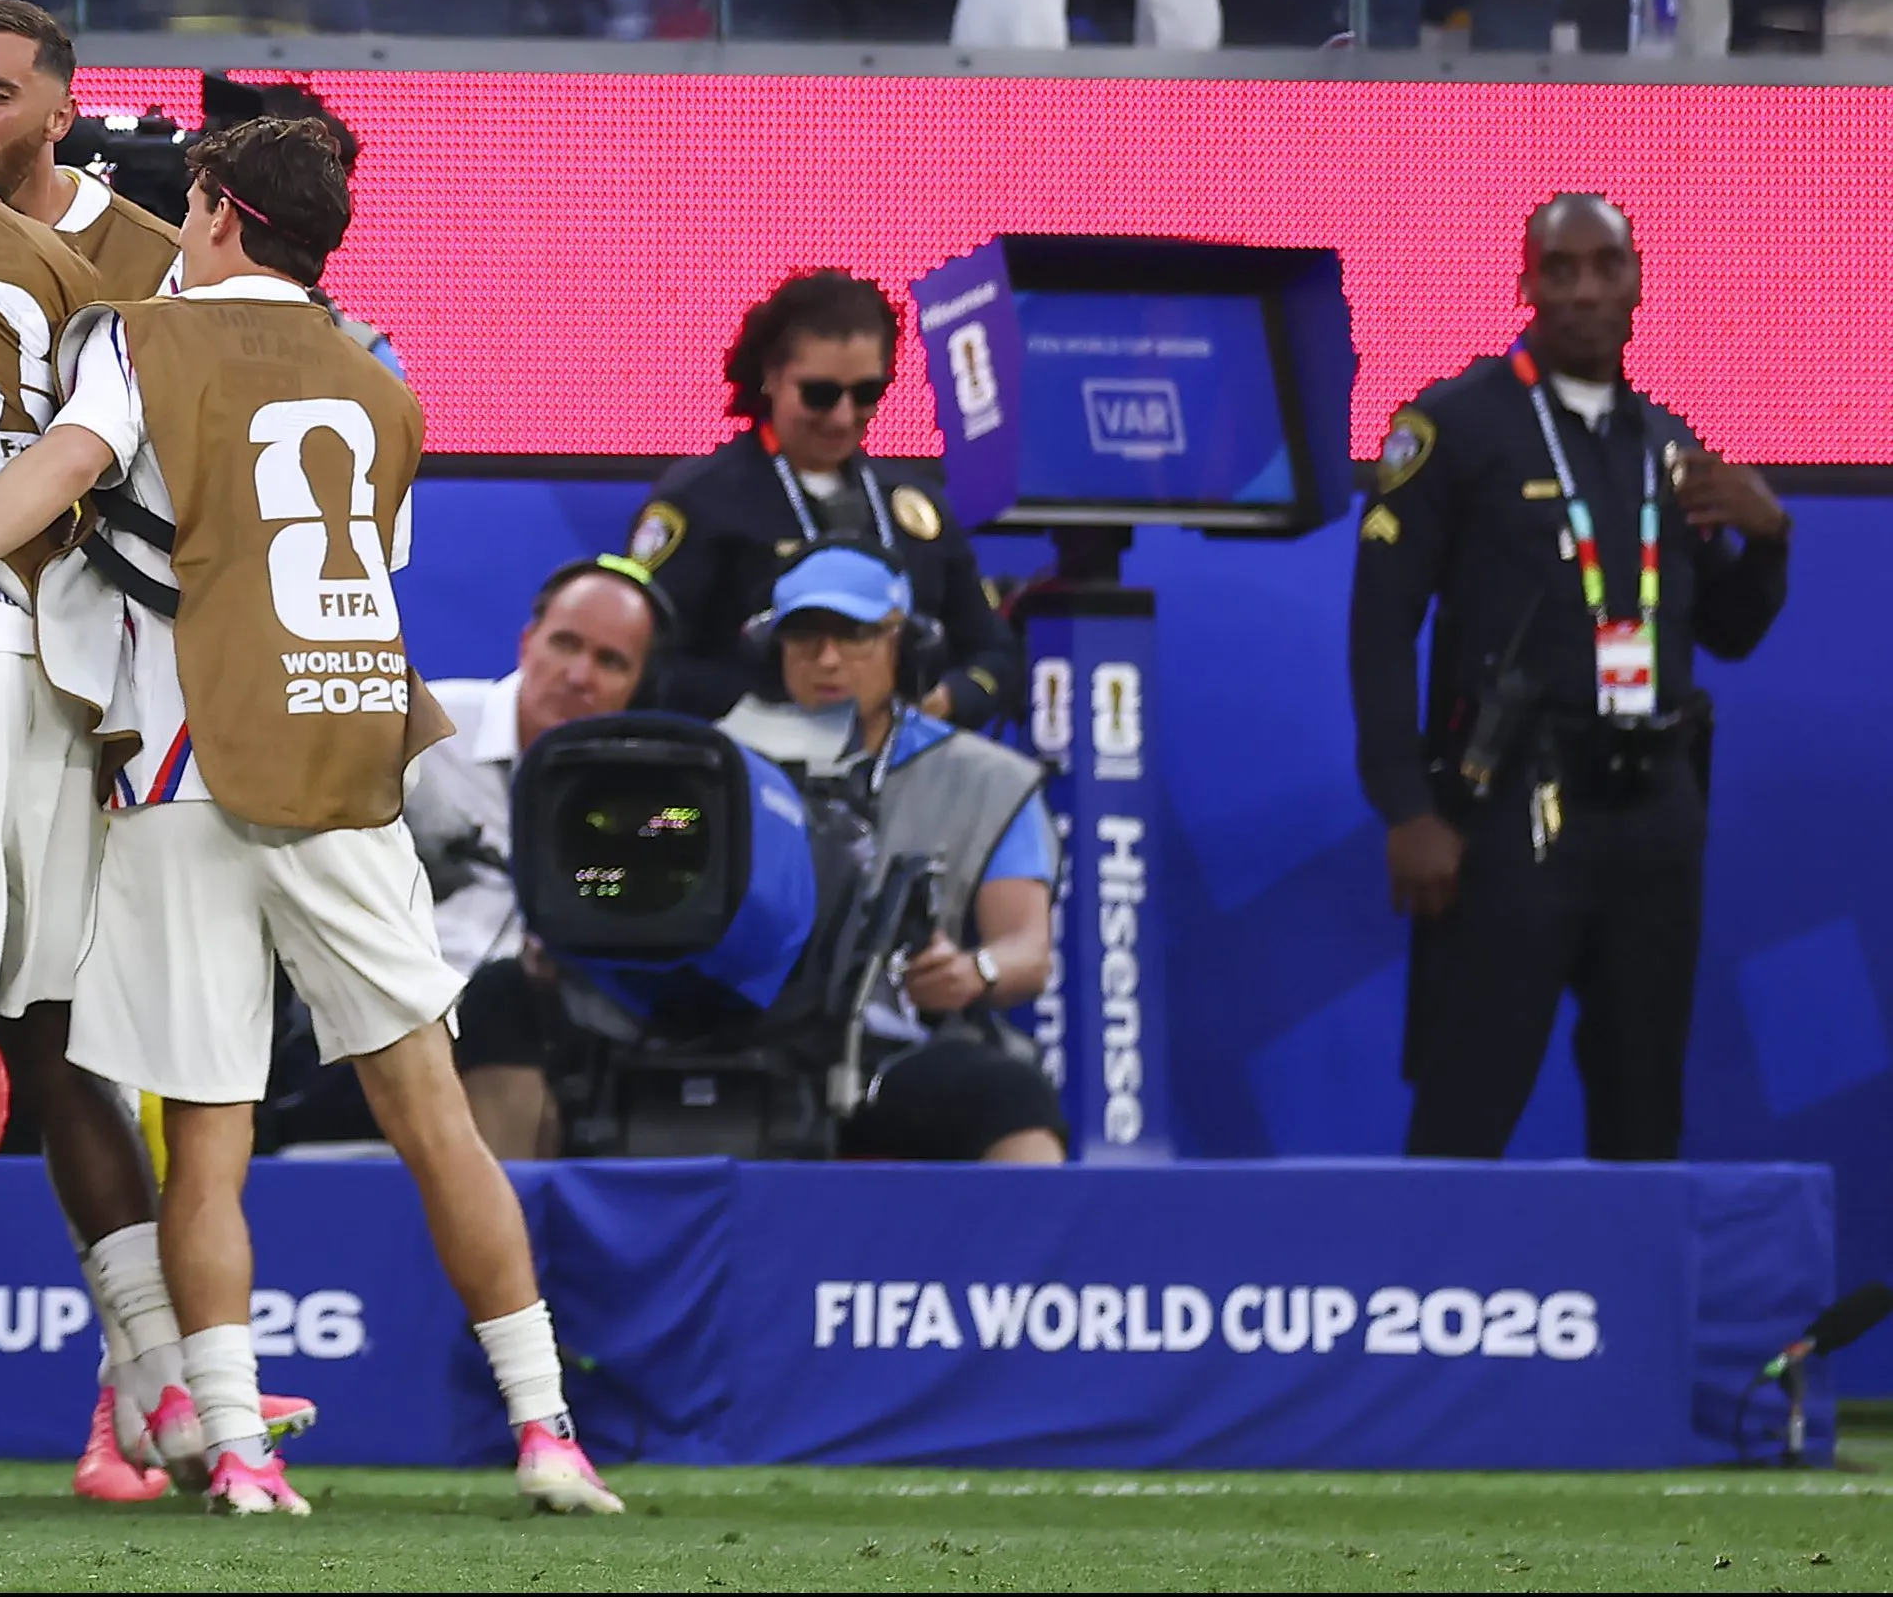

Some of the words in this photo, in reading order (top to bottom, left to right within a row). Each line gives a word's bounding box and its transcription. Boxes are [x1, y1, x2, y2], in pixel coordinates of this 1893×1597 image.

[1098, 398, 1170, 435] VAR
[318, 593, 380, 618] FIFA
[280, 650, 375, 676] WORLD
[286, 677, 410, 716] 2026
[1096, 815, 1146, 1145] Hisense
[249, 1288, 366, 1360] 26
[814, 1282, 963, 1351] FIFA
[966, 1283, 1213, 1354] WORLD
[1221, 1284, 1357, 1353] CUP
[1364, 1286, 1600, 1361] 2026
